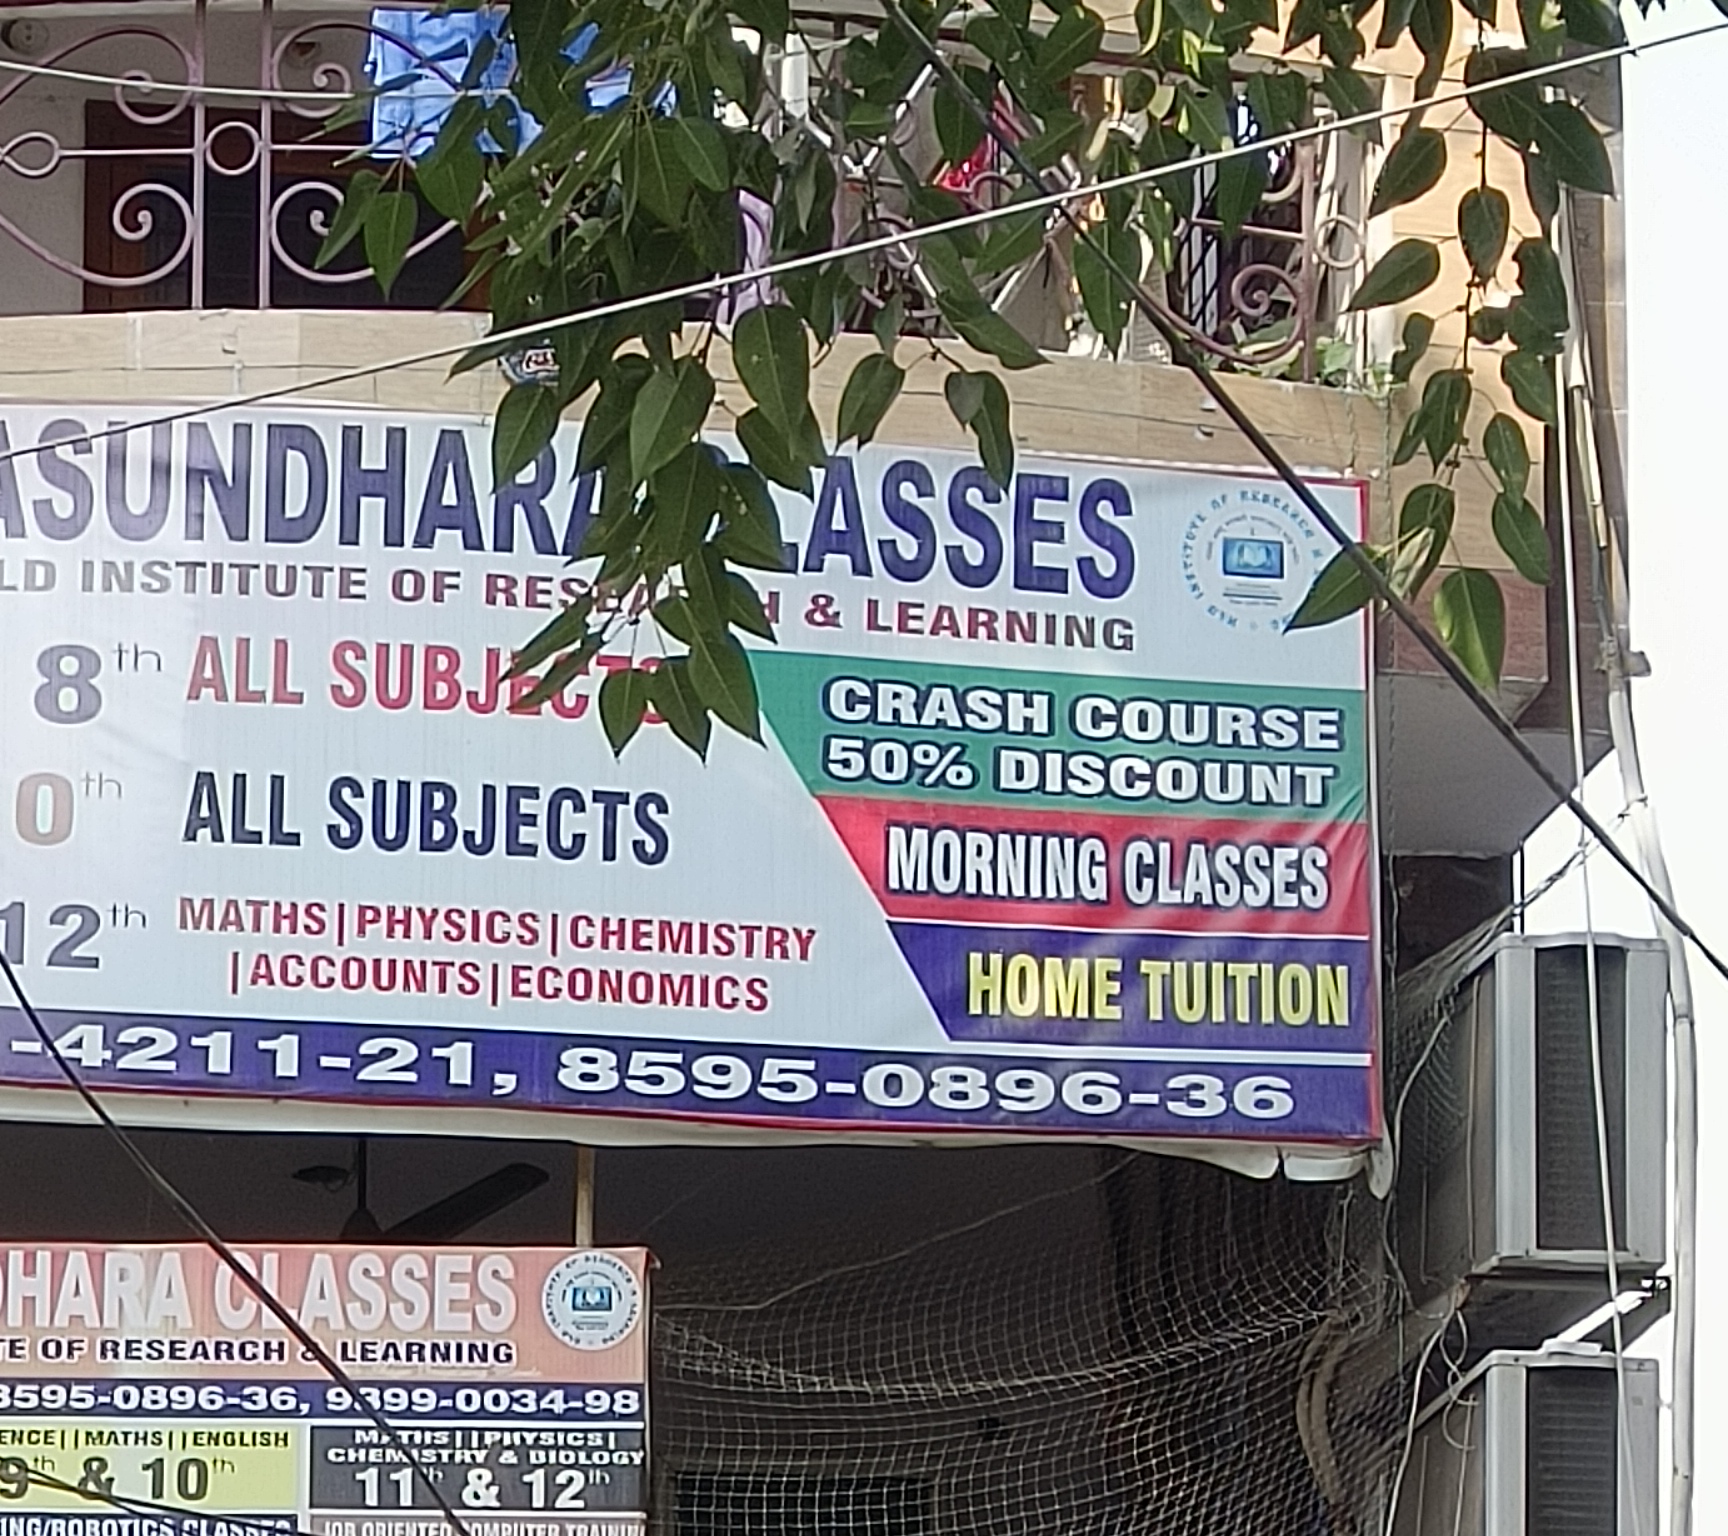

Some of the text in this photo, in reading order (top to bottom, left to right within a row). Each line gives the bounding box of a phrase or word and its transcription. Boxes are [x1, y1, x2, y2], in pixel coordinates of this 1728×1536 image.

[702, 447, 1135, 600] ASSES
[81, 558, 368, 602] INSTITUTE
[391, 567, 462, 605] OF
[804, 591, 843, 630] &
[866, 598, 1136, 652] LEARNING
[186, 635, 306, 706] ALL
[329, 640, 670, 724] SUBJEC
[826, 677, 1343, 751] CRASH COURSE
[825, 737, 1334, 805] 50% DISCOUNT
[181, 769, 302, 847] ALL
[326, 775, 671, 866] SUBJECTS
[887, 825, 1330, 909] MORNING CLASSES
[967, 951, 1350, 1027] HOME TUITION
[556, 1046, 1296, 1119] 8595-0896-36
[214, 1250, 517, 1335] CLASSES
[39, 1337, 86, 1363] OF
[98, 1338, 287, 1364] RESEARCH
[340, 1340, 516, 1366] LEARNING
[76, 1455, 116, 1501] &
[460, 1467, 502, 1508] &
[498, 1450, 519, 1466] &
[528, 1450, 645, 1467] BIOLOGY
